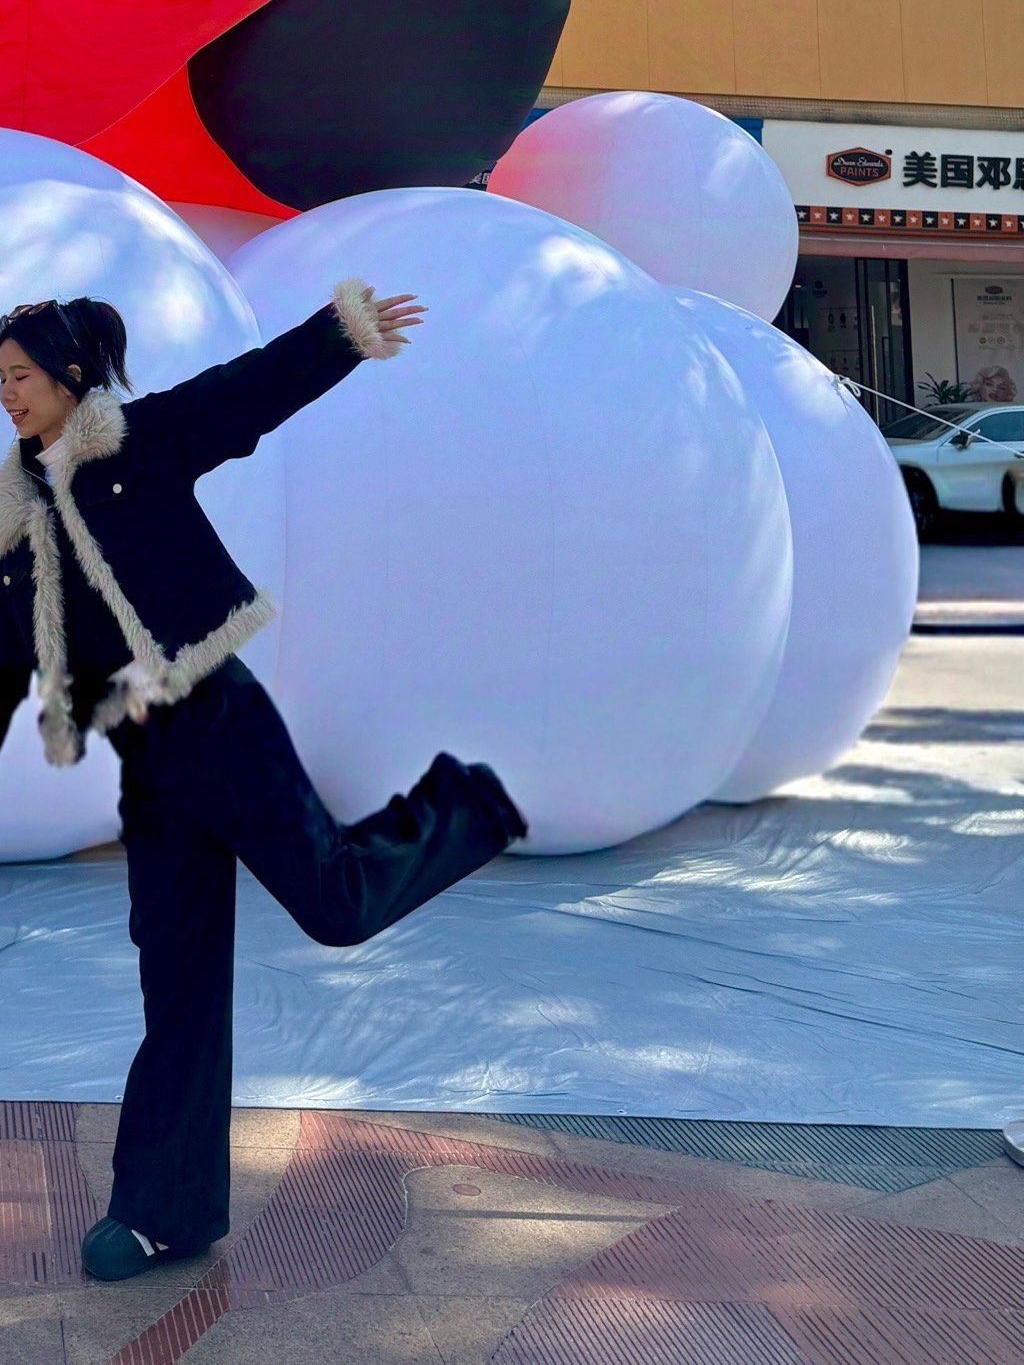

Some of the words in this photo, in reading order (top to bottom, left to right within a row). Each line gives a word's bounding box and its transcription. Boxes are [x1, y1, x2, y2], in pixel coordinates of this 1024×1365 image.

[840, 166, 879, 177] PAINTS
[902, 150, 1024, 190] 美国邓
